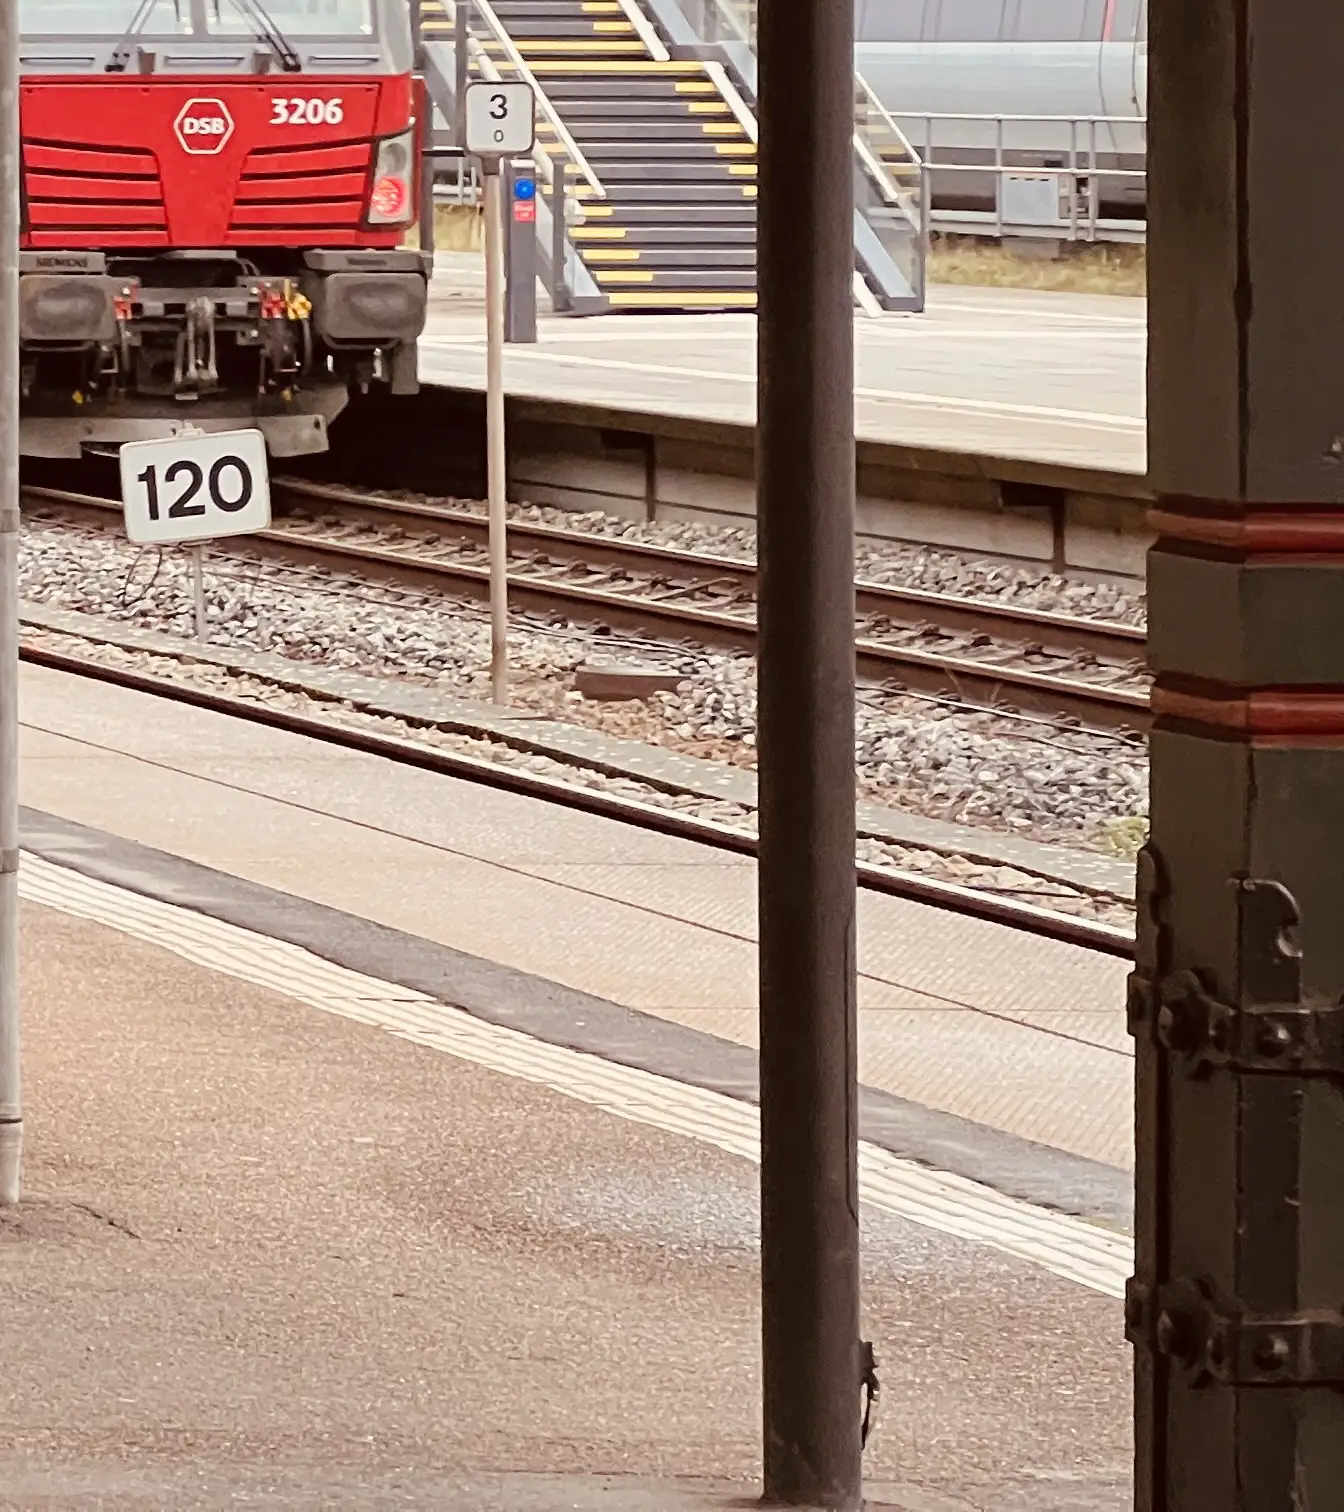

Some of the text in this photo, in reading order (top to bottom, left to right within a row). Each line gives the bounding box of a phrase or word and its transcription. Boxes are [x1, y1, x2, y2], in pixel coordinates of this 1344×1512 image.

[269, 97, 344, 125] 3206
[489, 93, 508, 120] 3
[183, 117, 226, 135] DSB
[493, 129, 504, 143] 0
[137, 454, 253, 521] 120
